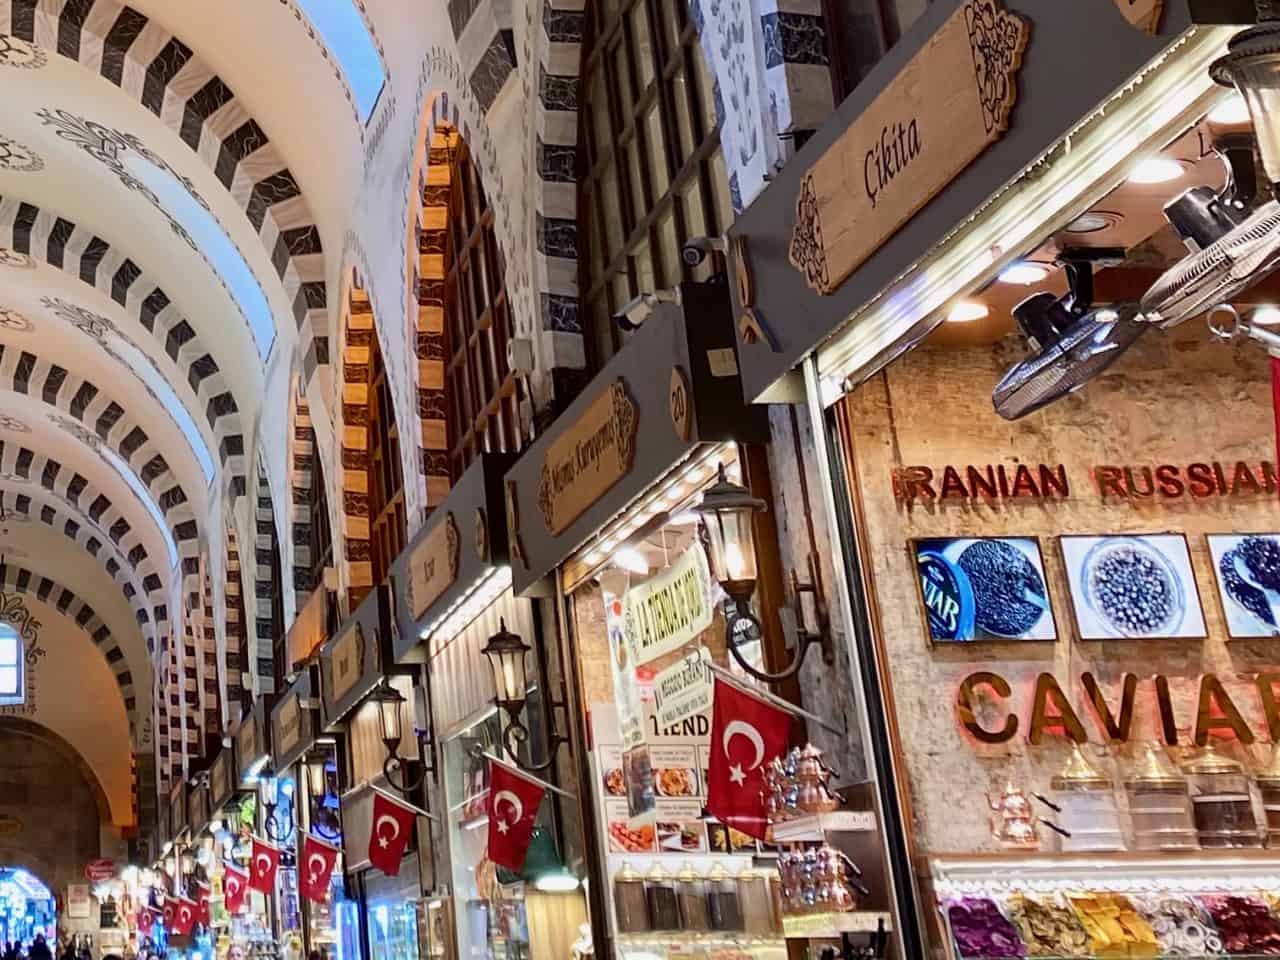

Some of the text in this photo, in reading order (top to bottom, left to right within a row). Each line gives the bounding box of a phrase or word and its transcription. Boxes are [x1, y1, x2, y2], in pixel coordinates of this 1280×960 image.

[864, 118, 921, 209] Çikita
[671, 385, 686, 423] 20
[892, 463, 1070, 499] IRANIAN
[649, 715, 709, 737] TEND
